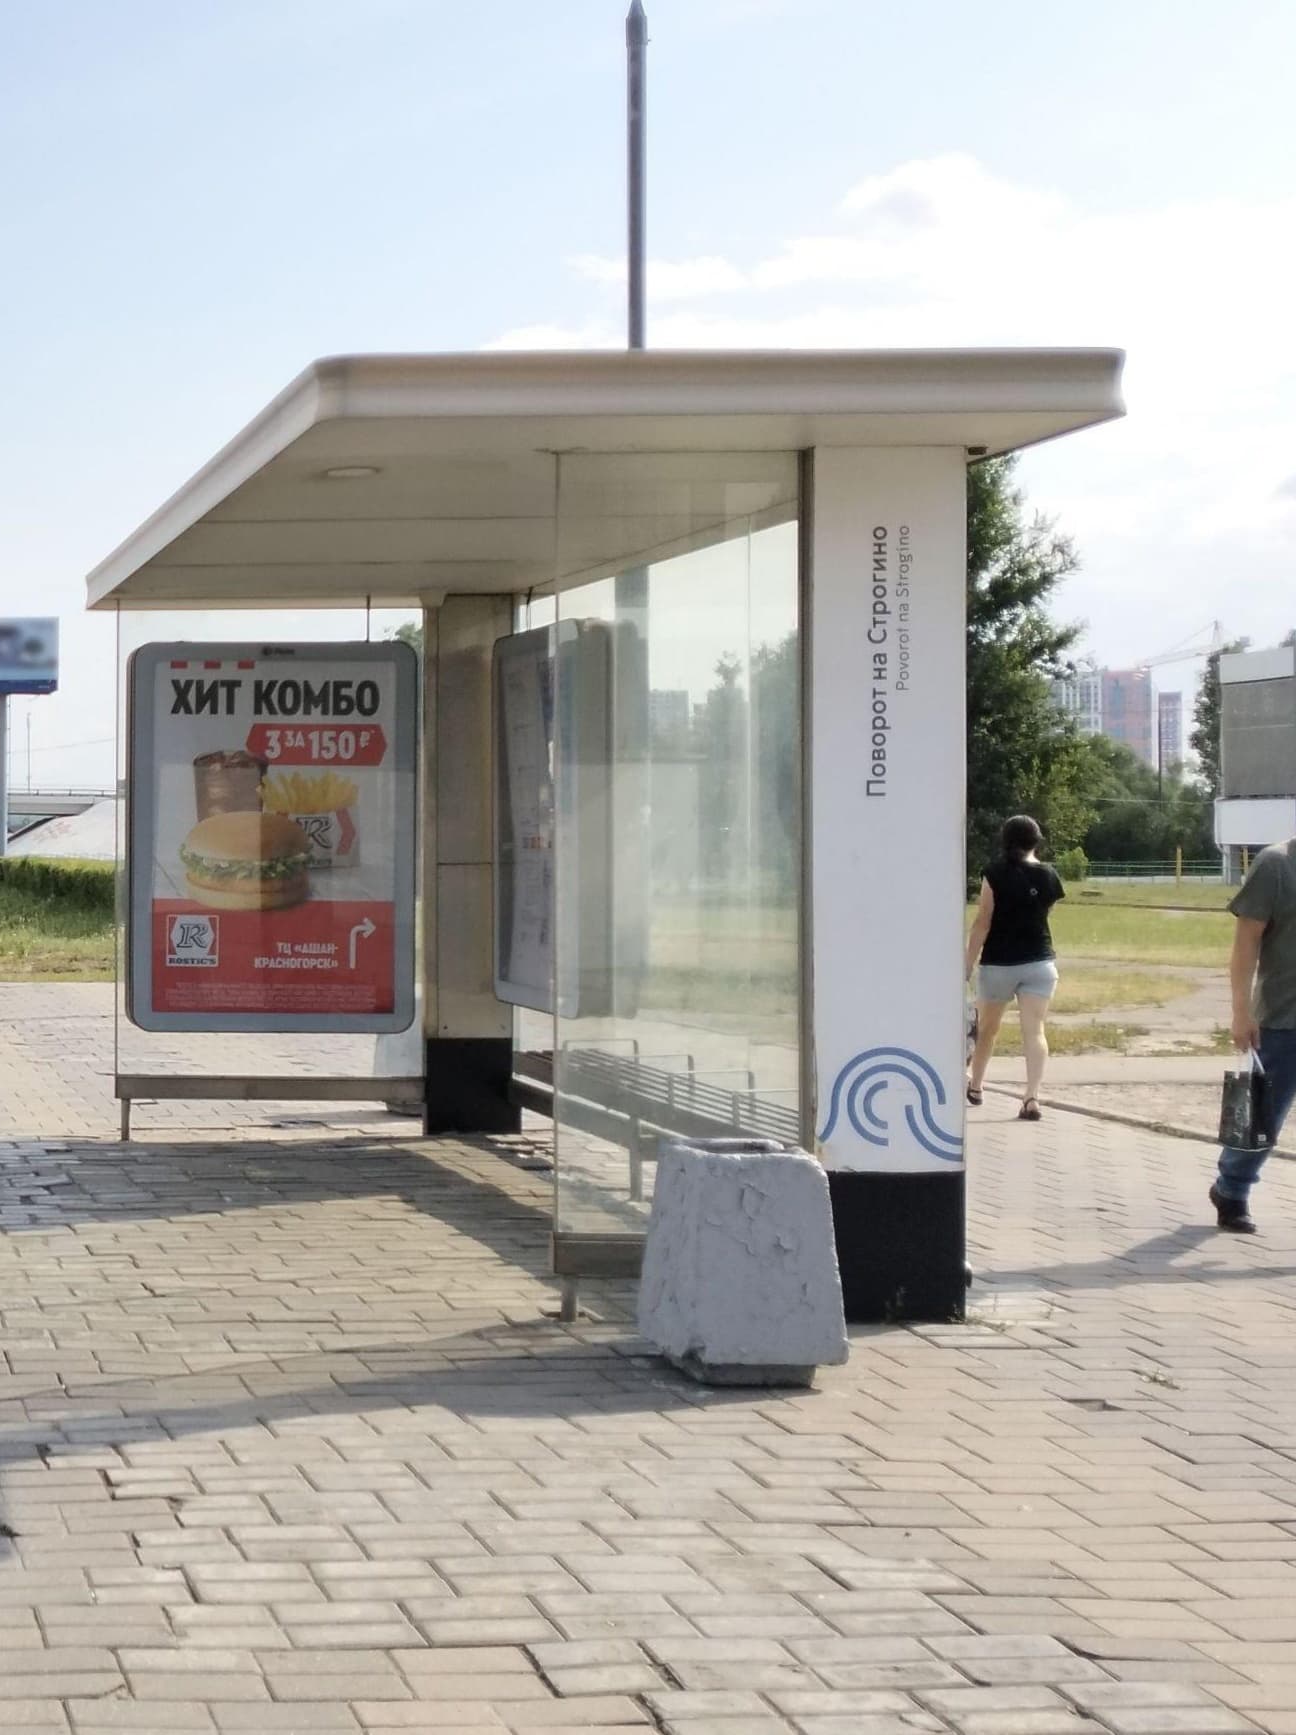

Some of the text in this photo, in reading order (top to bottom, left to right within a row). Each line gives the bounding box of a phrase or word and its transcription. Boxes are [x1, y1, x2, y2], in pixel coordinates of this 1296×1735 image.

[895, 525, 913, 691] Povorot na Strogino
[866, 526, 891, 796] Поворот на Строгино
[170, 679, 380, 717] ХИТ КОМБО
[264, 730, 282, 759] 3
[277, 942, 292, 955] ТЦ
